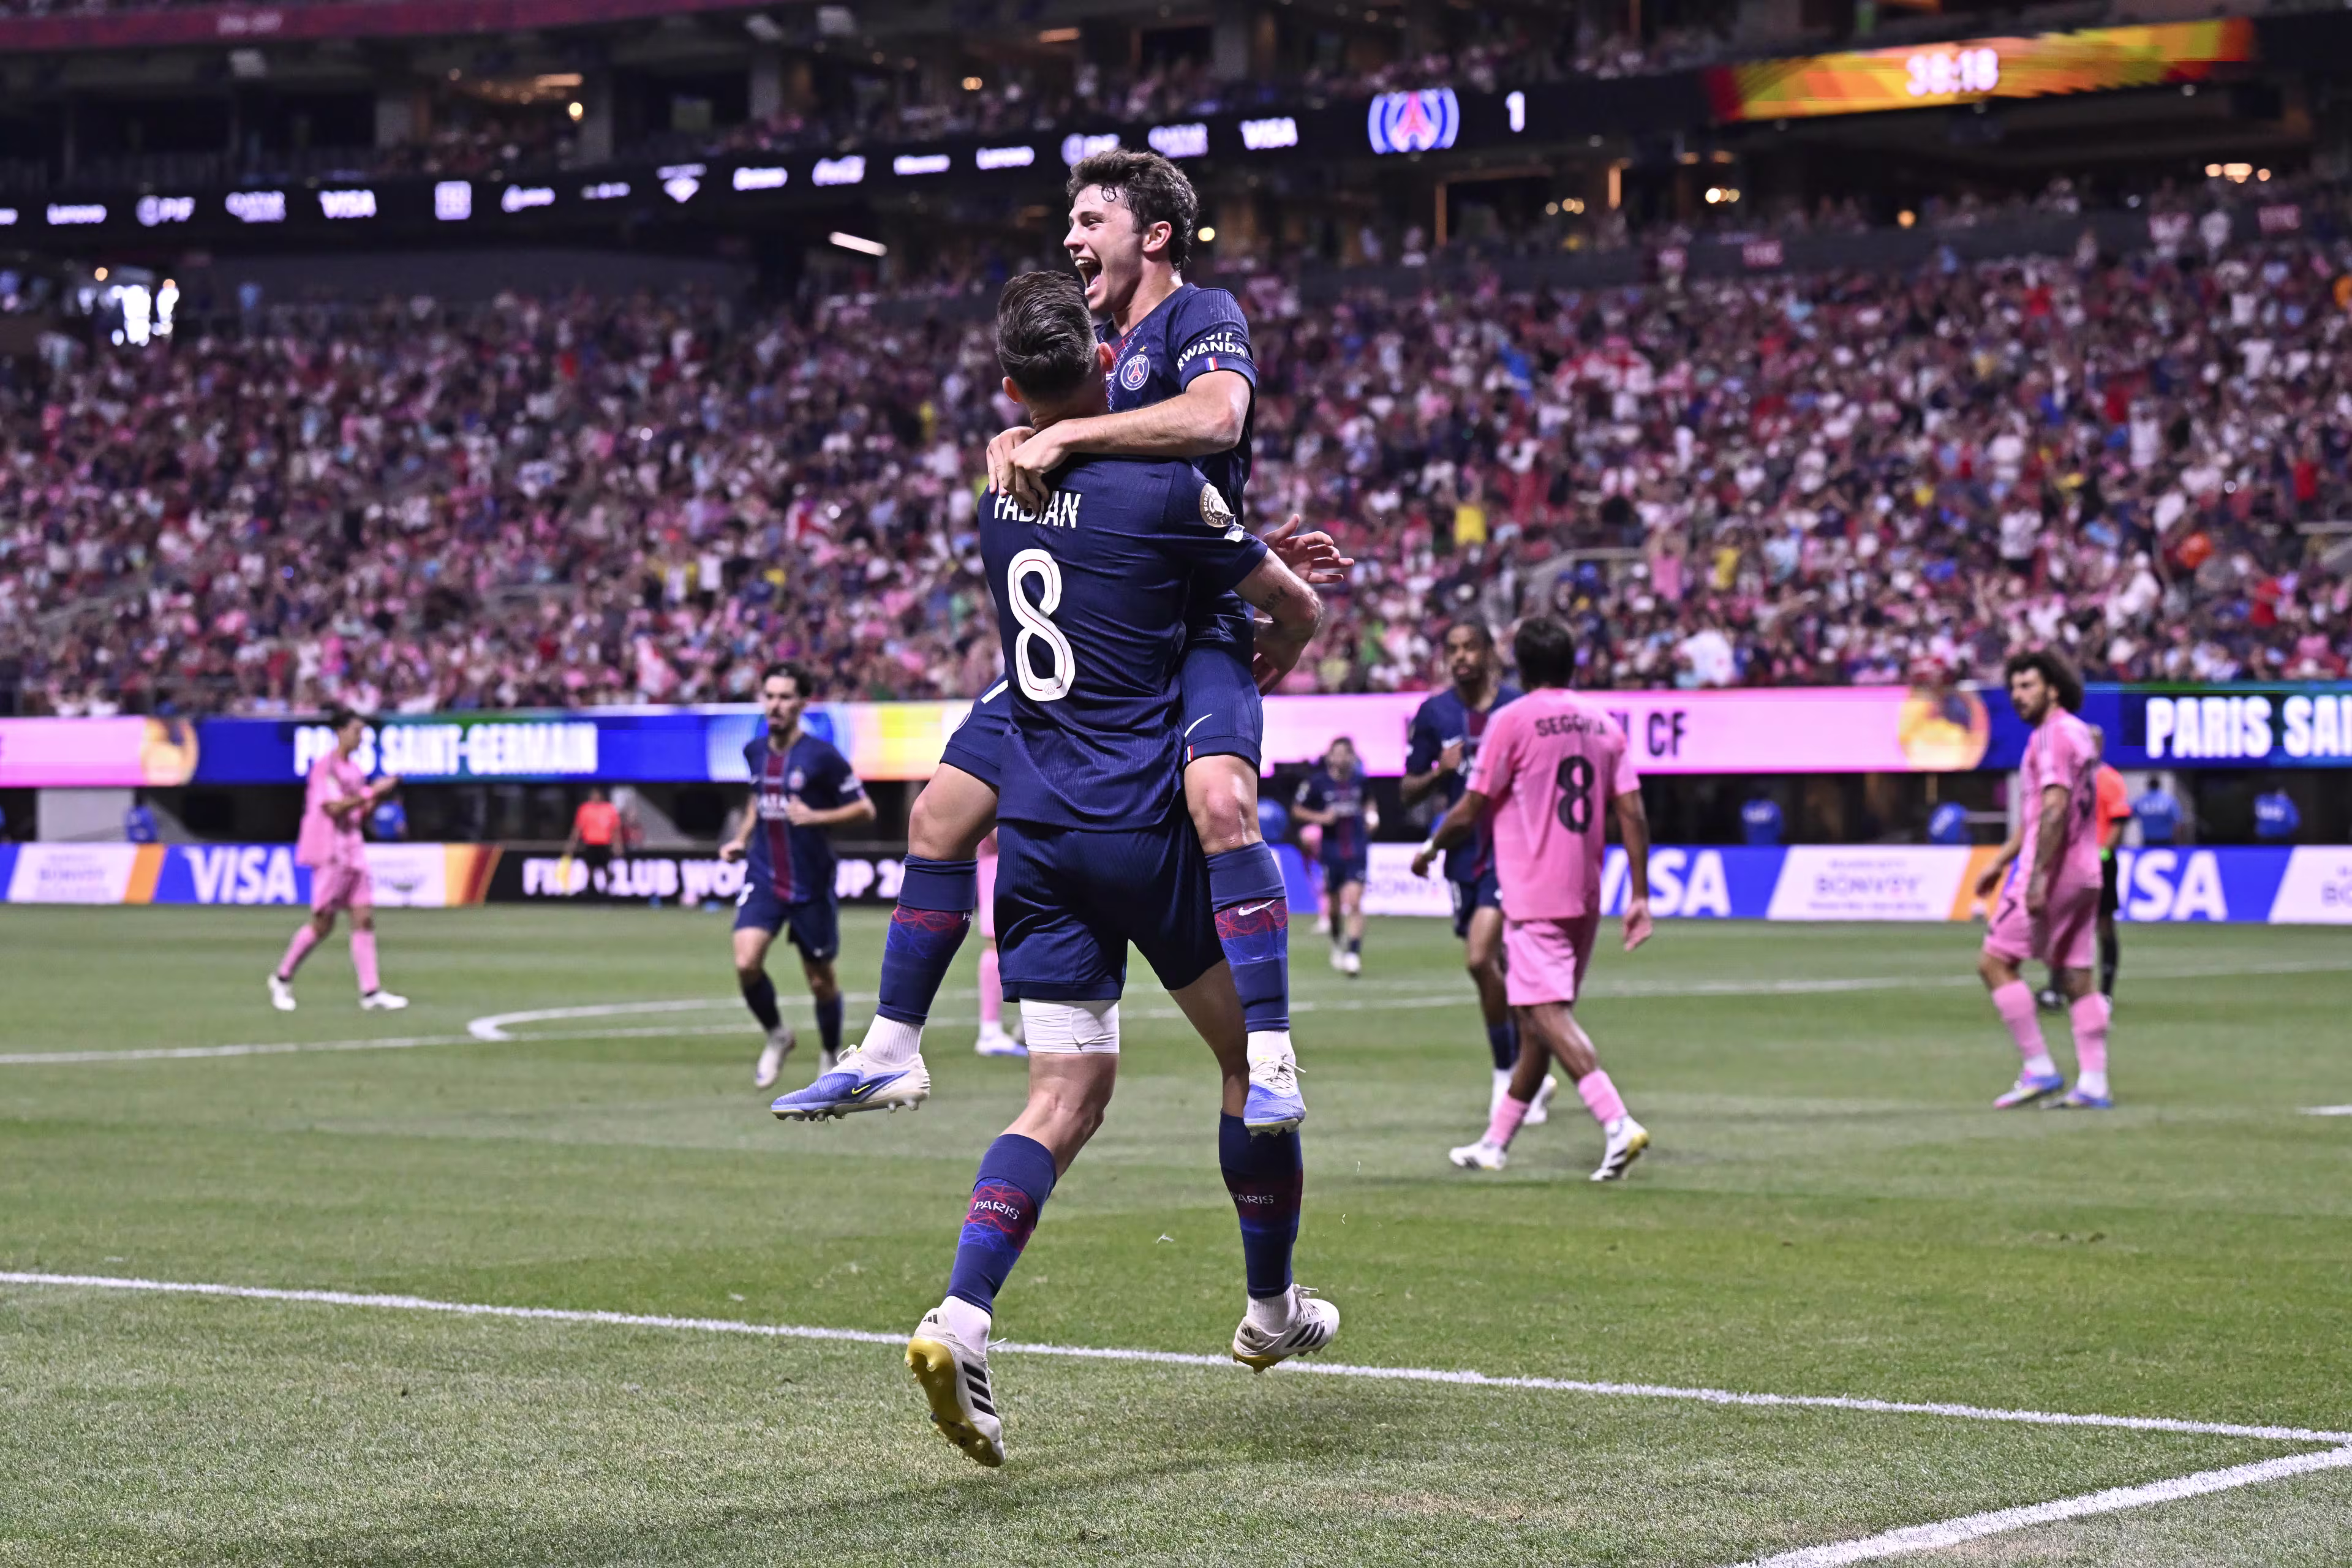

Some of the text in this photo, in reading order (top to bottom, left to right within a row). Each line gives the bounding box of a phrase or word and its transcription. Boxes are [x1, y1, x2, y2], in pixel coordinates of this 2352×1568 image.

[1506, 91, 1525, 132] 1
[1128, 356, 1146, 367] PARIS
[1177, 341, 1245, 371] RWANDA
[1206, 513, 1218, 524] CLUB
[1008, 548, 1076, 701] 8
[1648, 711, 1686, 757] CF
[2146, 697, 2273, 759] PARIS
[1556, 755, 1594, 834] 8
[185, 847, 298, 903] VISA
[974, 1200, 1020, 1219] PARIS
